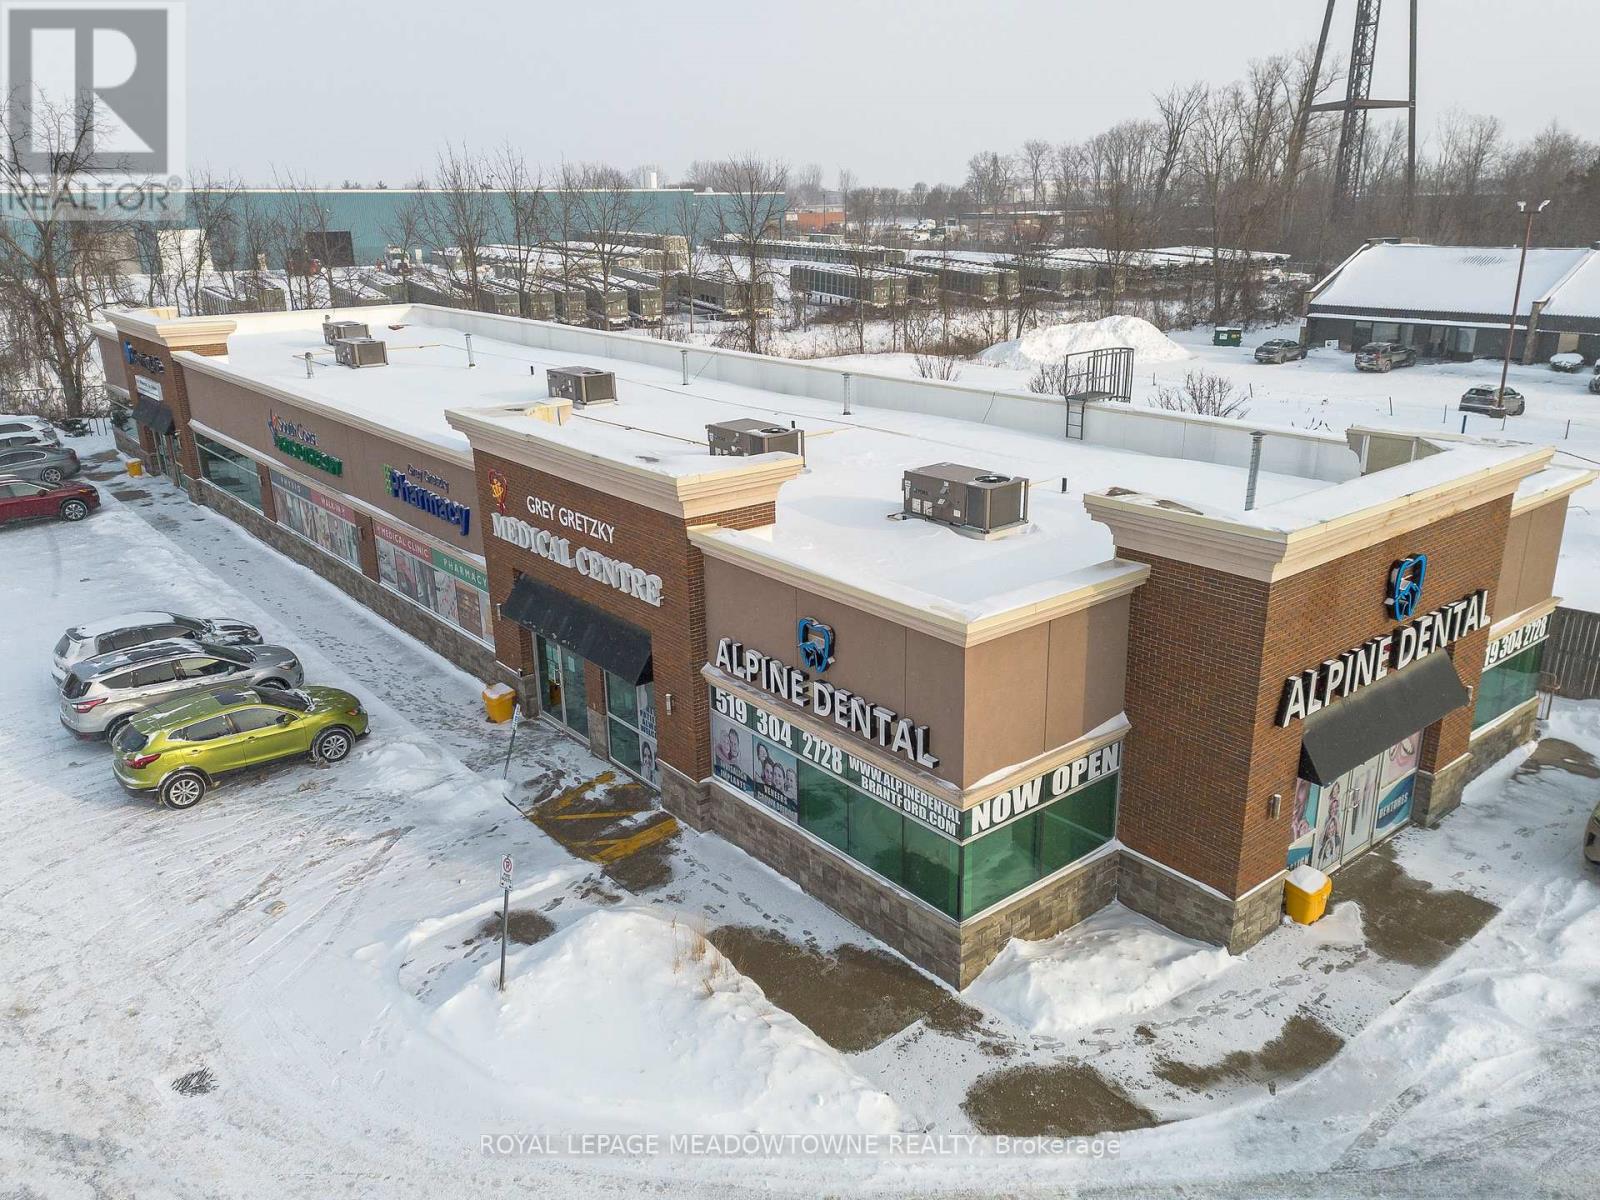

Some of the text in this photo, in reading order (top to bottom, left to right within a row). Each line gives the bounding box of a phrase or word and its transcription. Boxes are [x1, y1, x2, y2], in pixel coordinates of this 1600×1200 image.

[391, 469, 470, 537] Pharmacy
[527, 495, 615, 544] GREY GRETZKY
[381, 528, 430, 558] MEDICAL CLINIC
[443, 558, 487, 587] PHARMACY
[490, 512, 665, 608] MEDICAL CENTRE
[1276, 589, 1491, 729] ALPINE DENTAL
[1484, 615, 1548, 668] 19 304 2728
[715, 636, 940, 769] ALPINE DENTAL
[716, 687, 843, 775] 519 304 2728
[848, 755, 961, 825] WWW.ALPINEDENTAL
[861, 775, 957, 837] BRANTFORD.COM
[971, 742, 1120, 836] NOW OPEN
